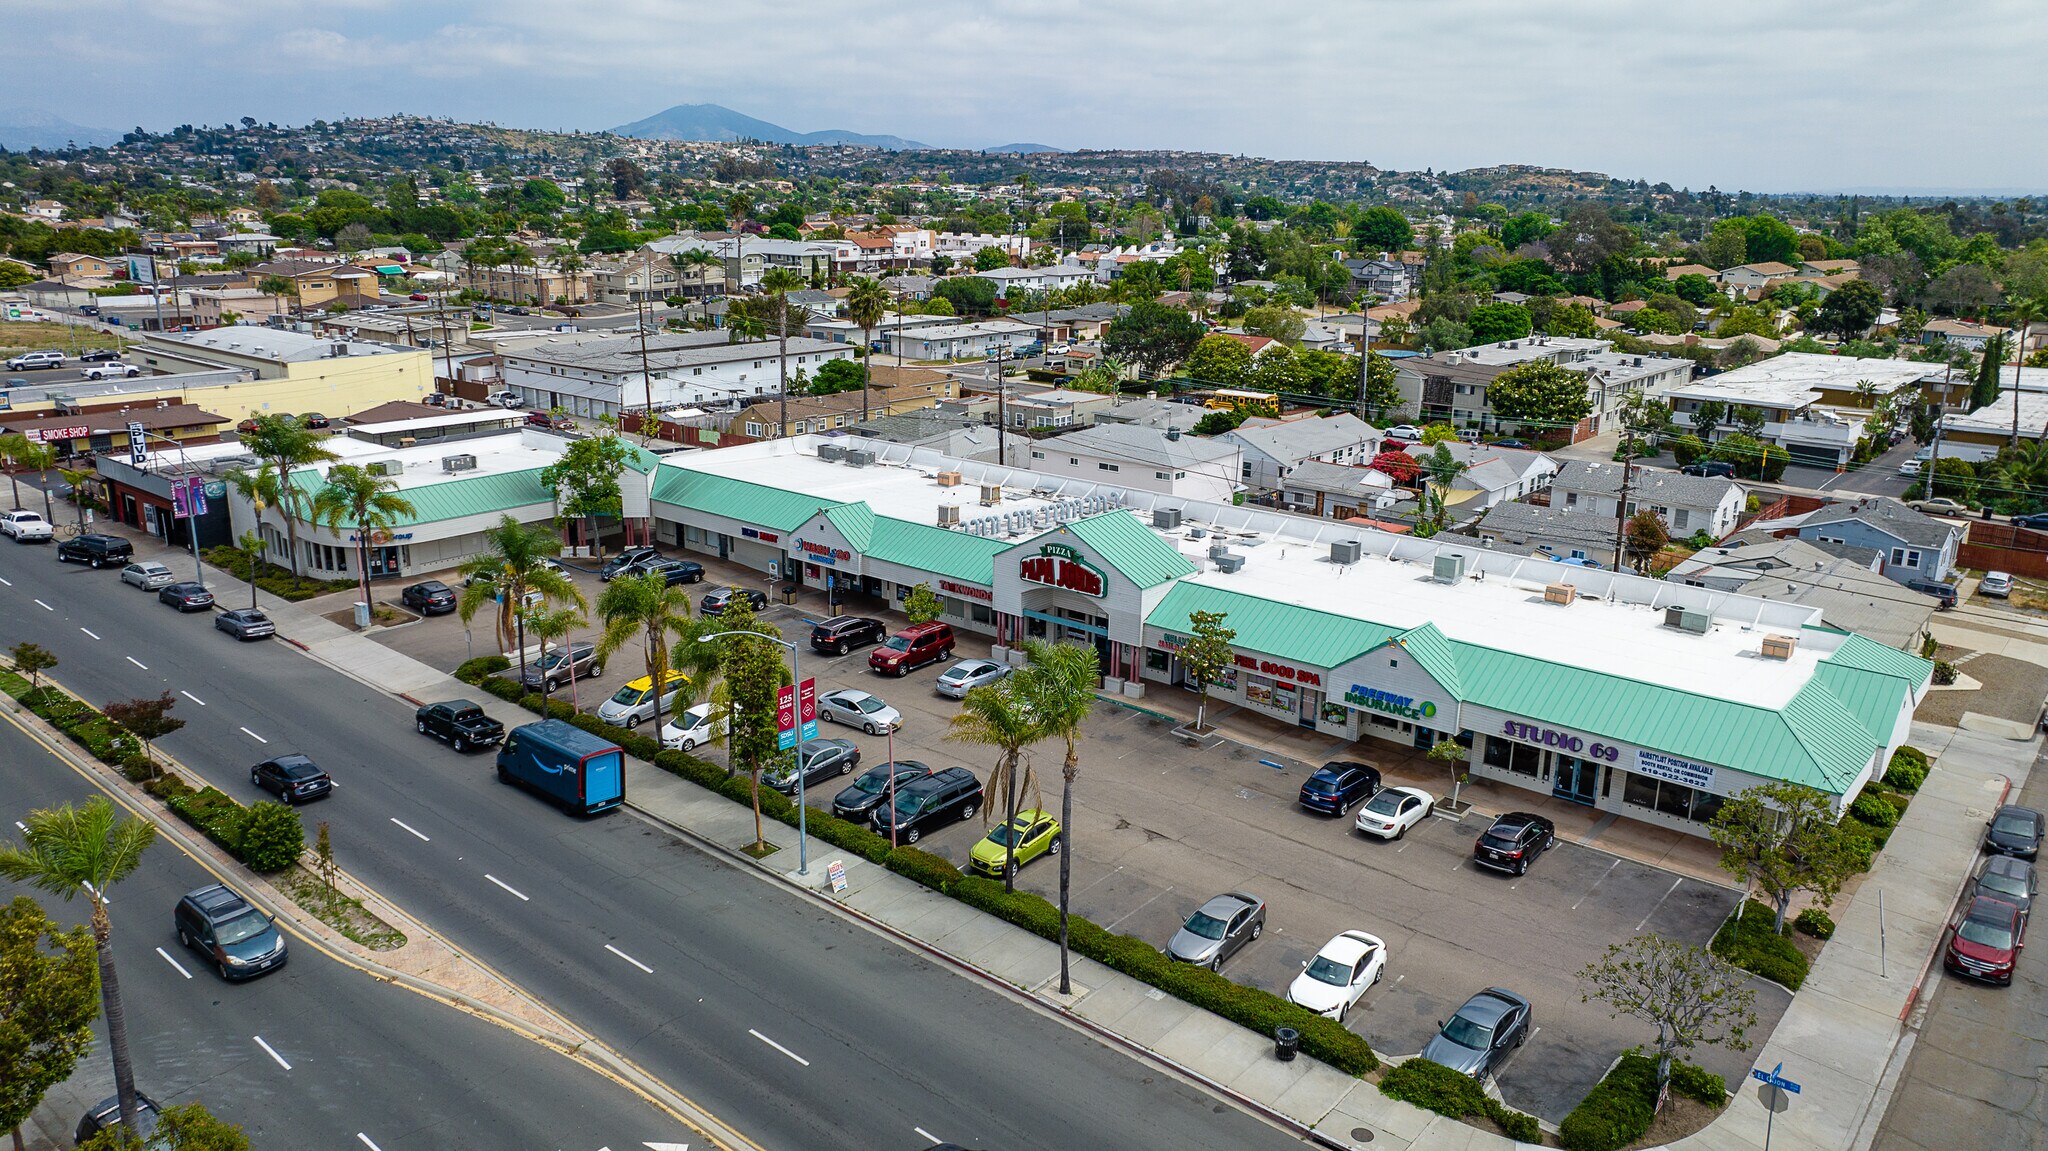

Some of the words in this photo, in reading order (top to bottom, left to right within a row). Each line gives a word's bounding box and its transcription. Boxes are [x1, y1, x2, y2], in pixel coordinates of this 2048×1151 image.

[42, 428, 68, 440] SMOKE
[69, 426, 88, 438] SHOP
[132, 428, 146, 463] BLVD
[803, 540, 830, 556] WASH
[808, 553, 836, 565] LAUNDRY
[1047, 545, 1071, 558] PIZZA
[1021, 557, 1055, 585] PAPA
[1234, 653, 1259, 671] FEEL
[1260, 662, 1295, 680] GOOD
[1297, 670, 1321, 686] SPA
[779, 693, 793, 705] 125
[1344, 692, 1420, 720] INSURANCE
[1350, 684, 1414, 707] FREEWAY
[1504, 720, 1584, 752] STUDIO
[1589, 742, 1619, 762] 69
[1639, 750, 1668, 764] HAIRSTYLIST
[1667, 757, 1689, 769] POSITION
[1689, 762, 1714, 775] AVAILABLE
[1641, 759, 1656, 767] BOOTH
[1656, 764, 1673, 773] RENTAL
[1680, 769, 1708, 781] COMMISSION
[1757, 1072, 1764, 1080] EL
[1766, 1076, 1786, 1088] CJON
